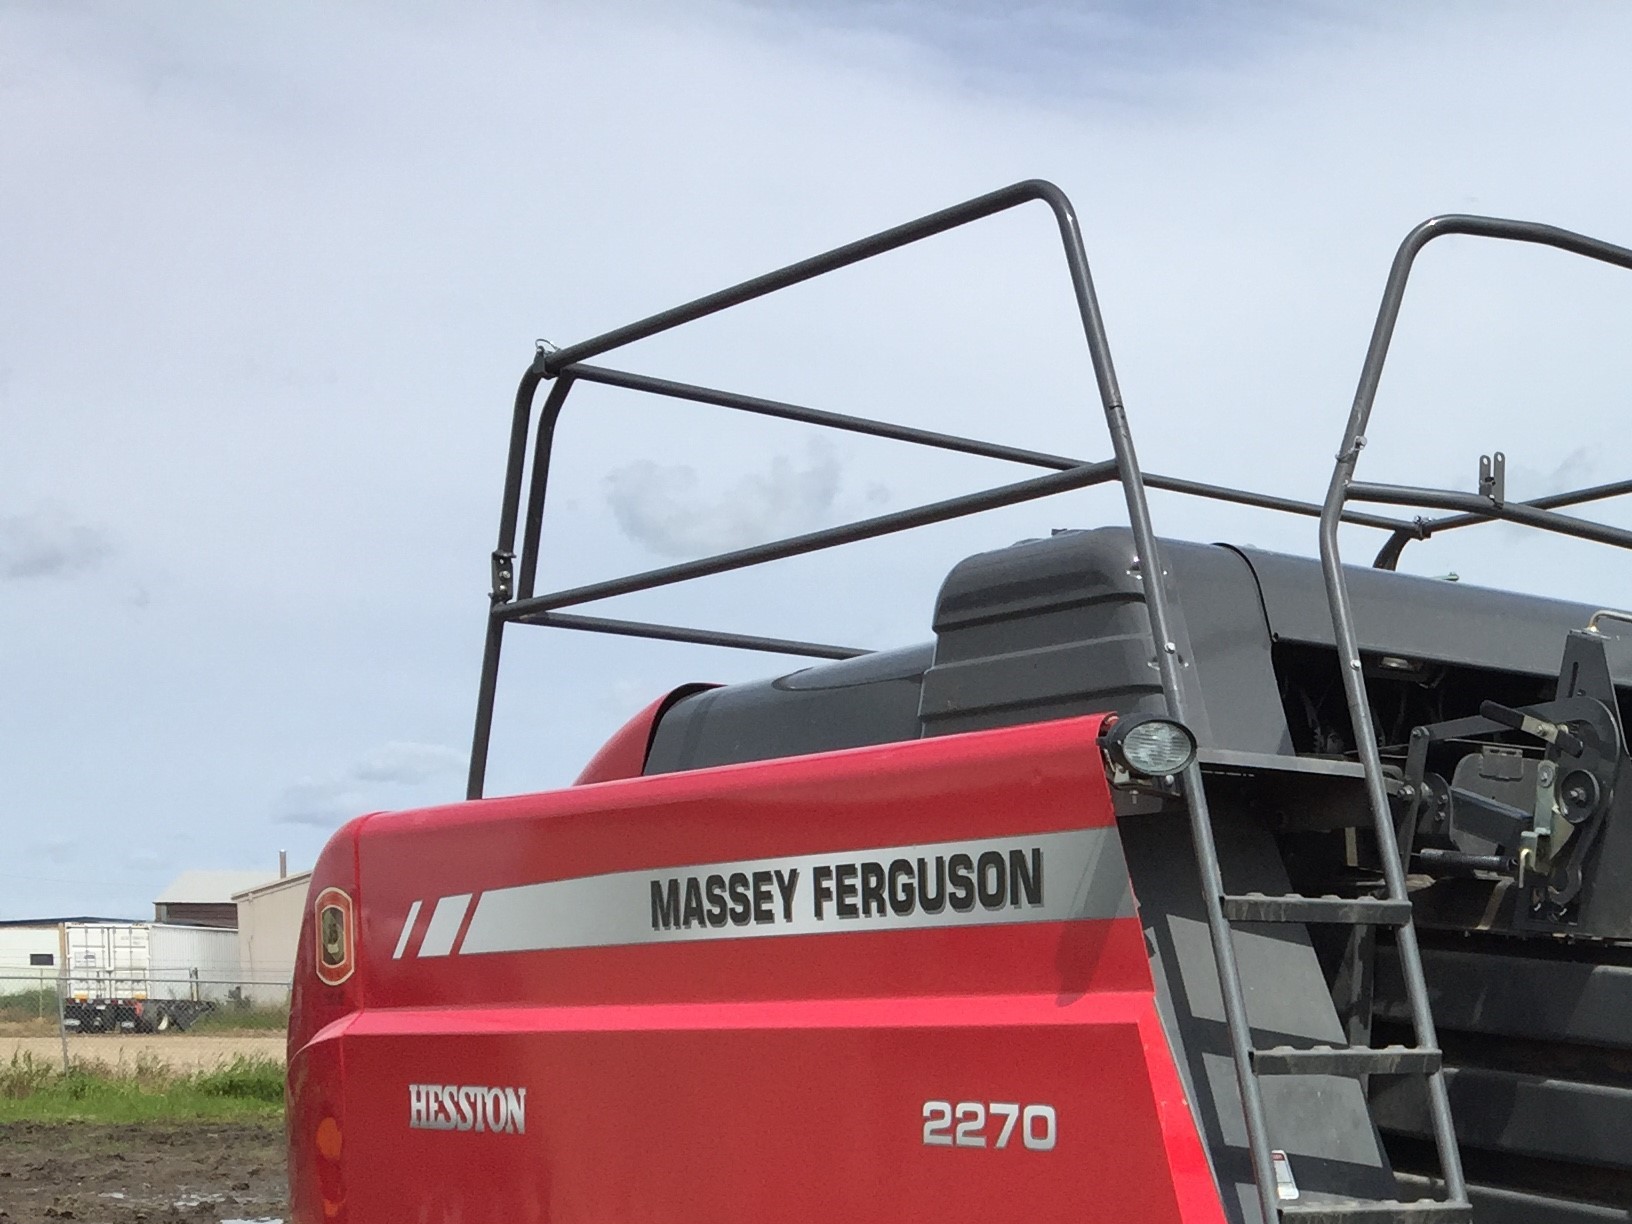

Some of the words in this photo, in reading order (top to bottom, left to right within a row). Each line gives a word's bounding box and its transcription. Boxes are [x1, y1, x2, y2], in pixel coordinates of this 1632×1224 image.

[650, 868, 800, 931] MASSEY
[812, 847, 1044, 921] FERGUSON
[408, 1084, 527, 1134] HESSTON
[921, 1101, 1057, 1152] 2270
